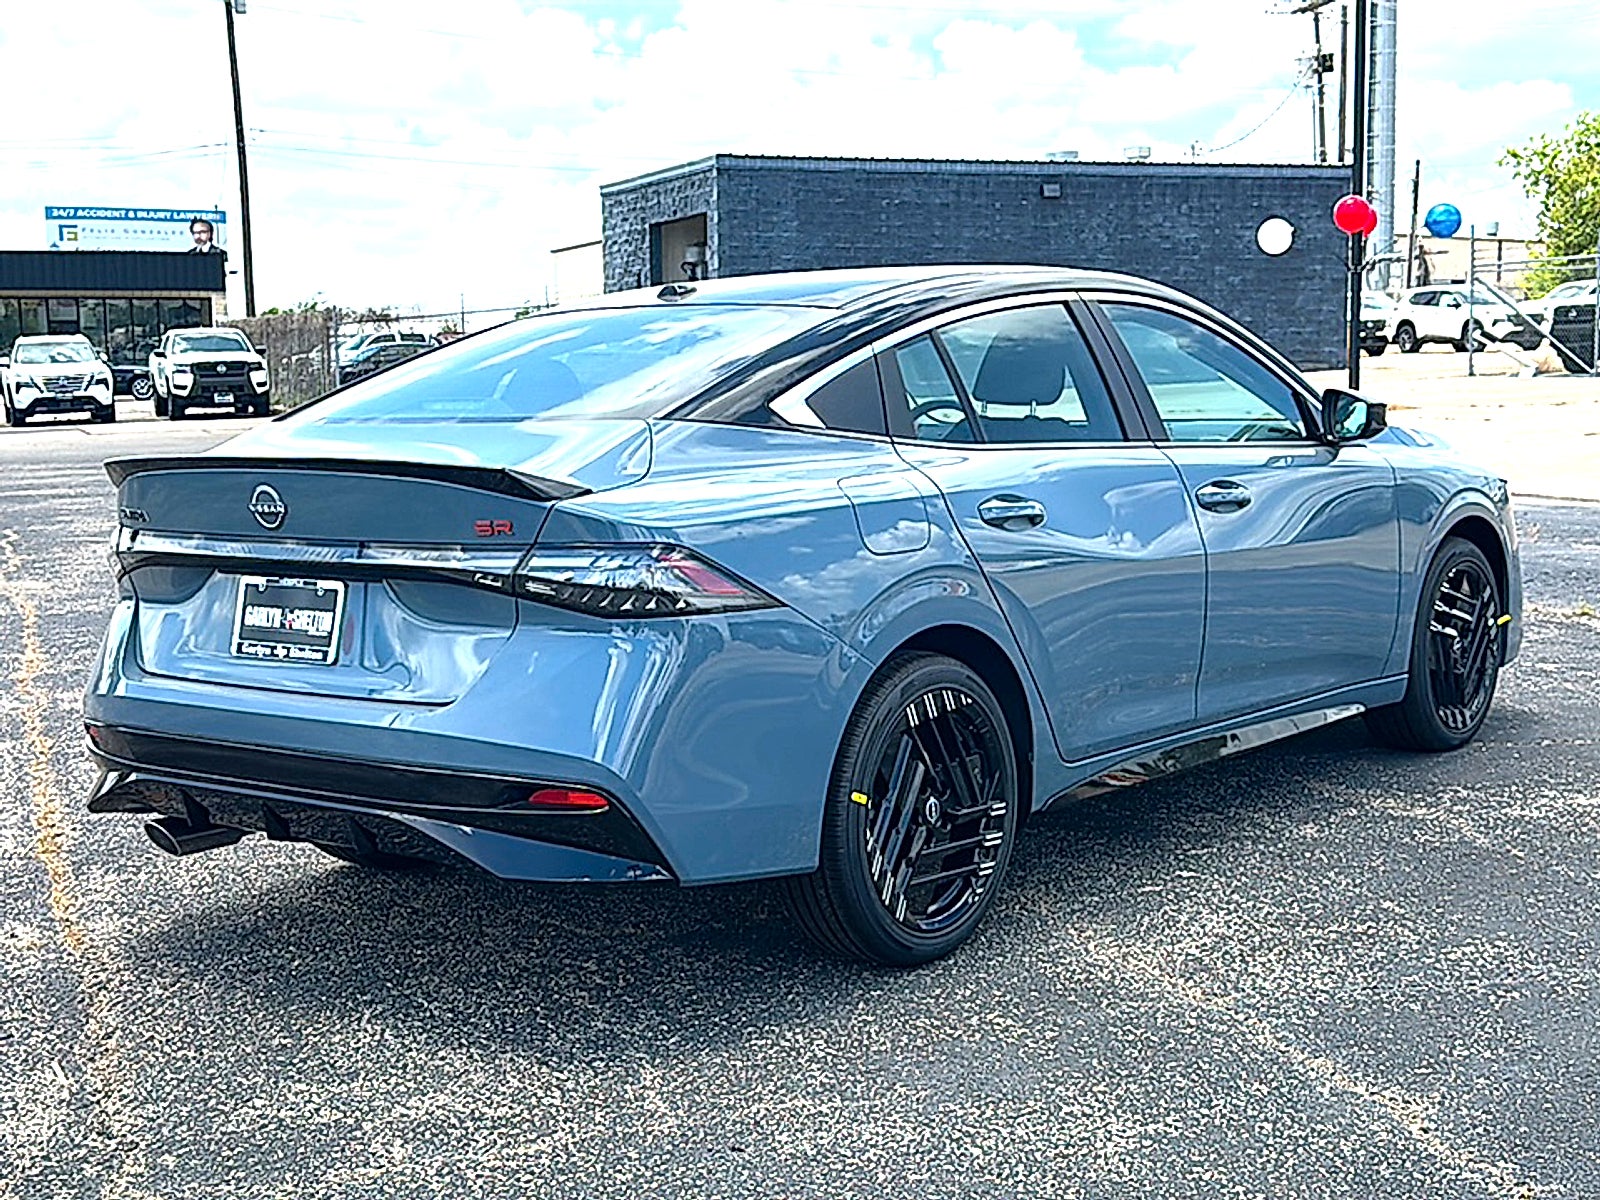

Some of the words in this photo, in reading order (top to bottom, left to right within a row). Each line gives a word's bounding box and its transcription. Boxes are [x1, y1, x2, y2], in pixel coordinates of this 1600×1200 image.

[52, 208, 75, 217] 24/7
[77, 208, 126, 218] ACCIDENT
[128, 210, 135, 218] &
[136, 210, 172, 219] INJURY
[473, 519, 513, 536] SR
[244, 605, 283, 628] GARLYN
[291, 609, 334, 632] SHELTON
